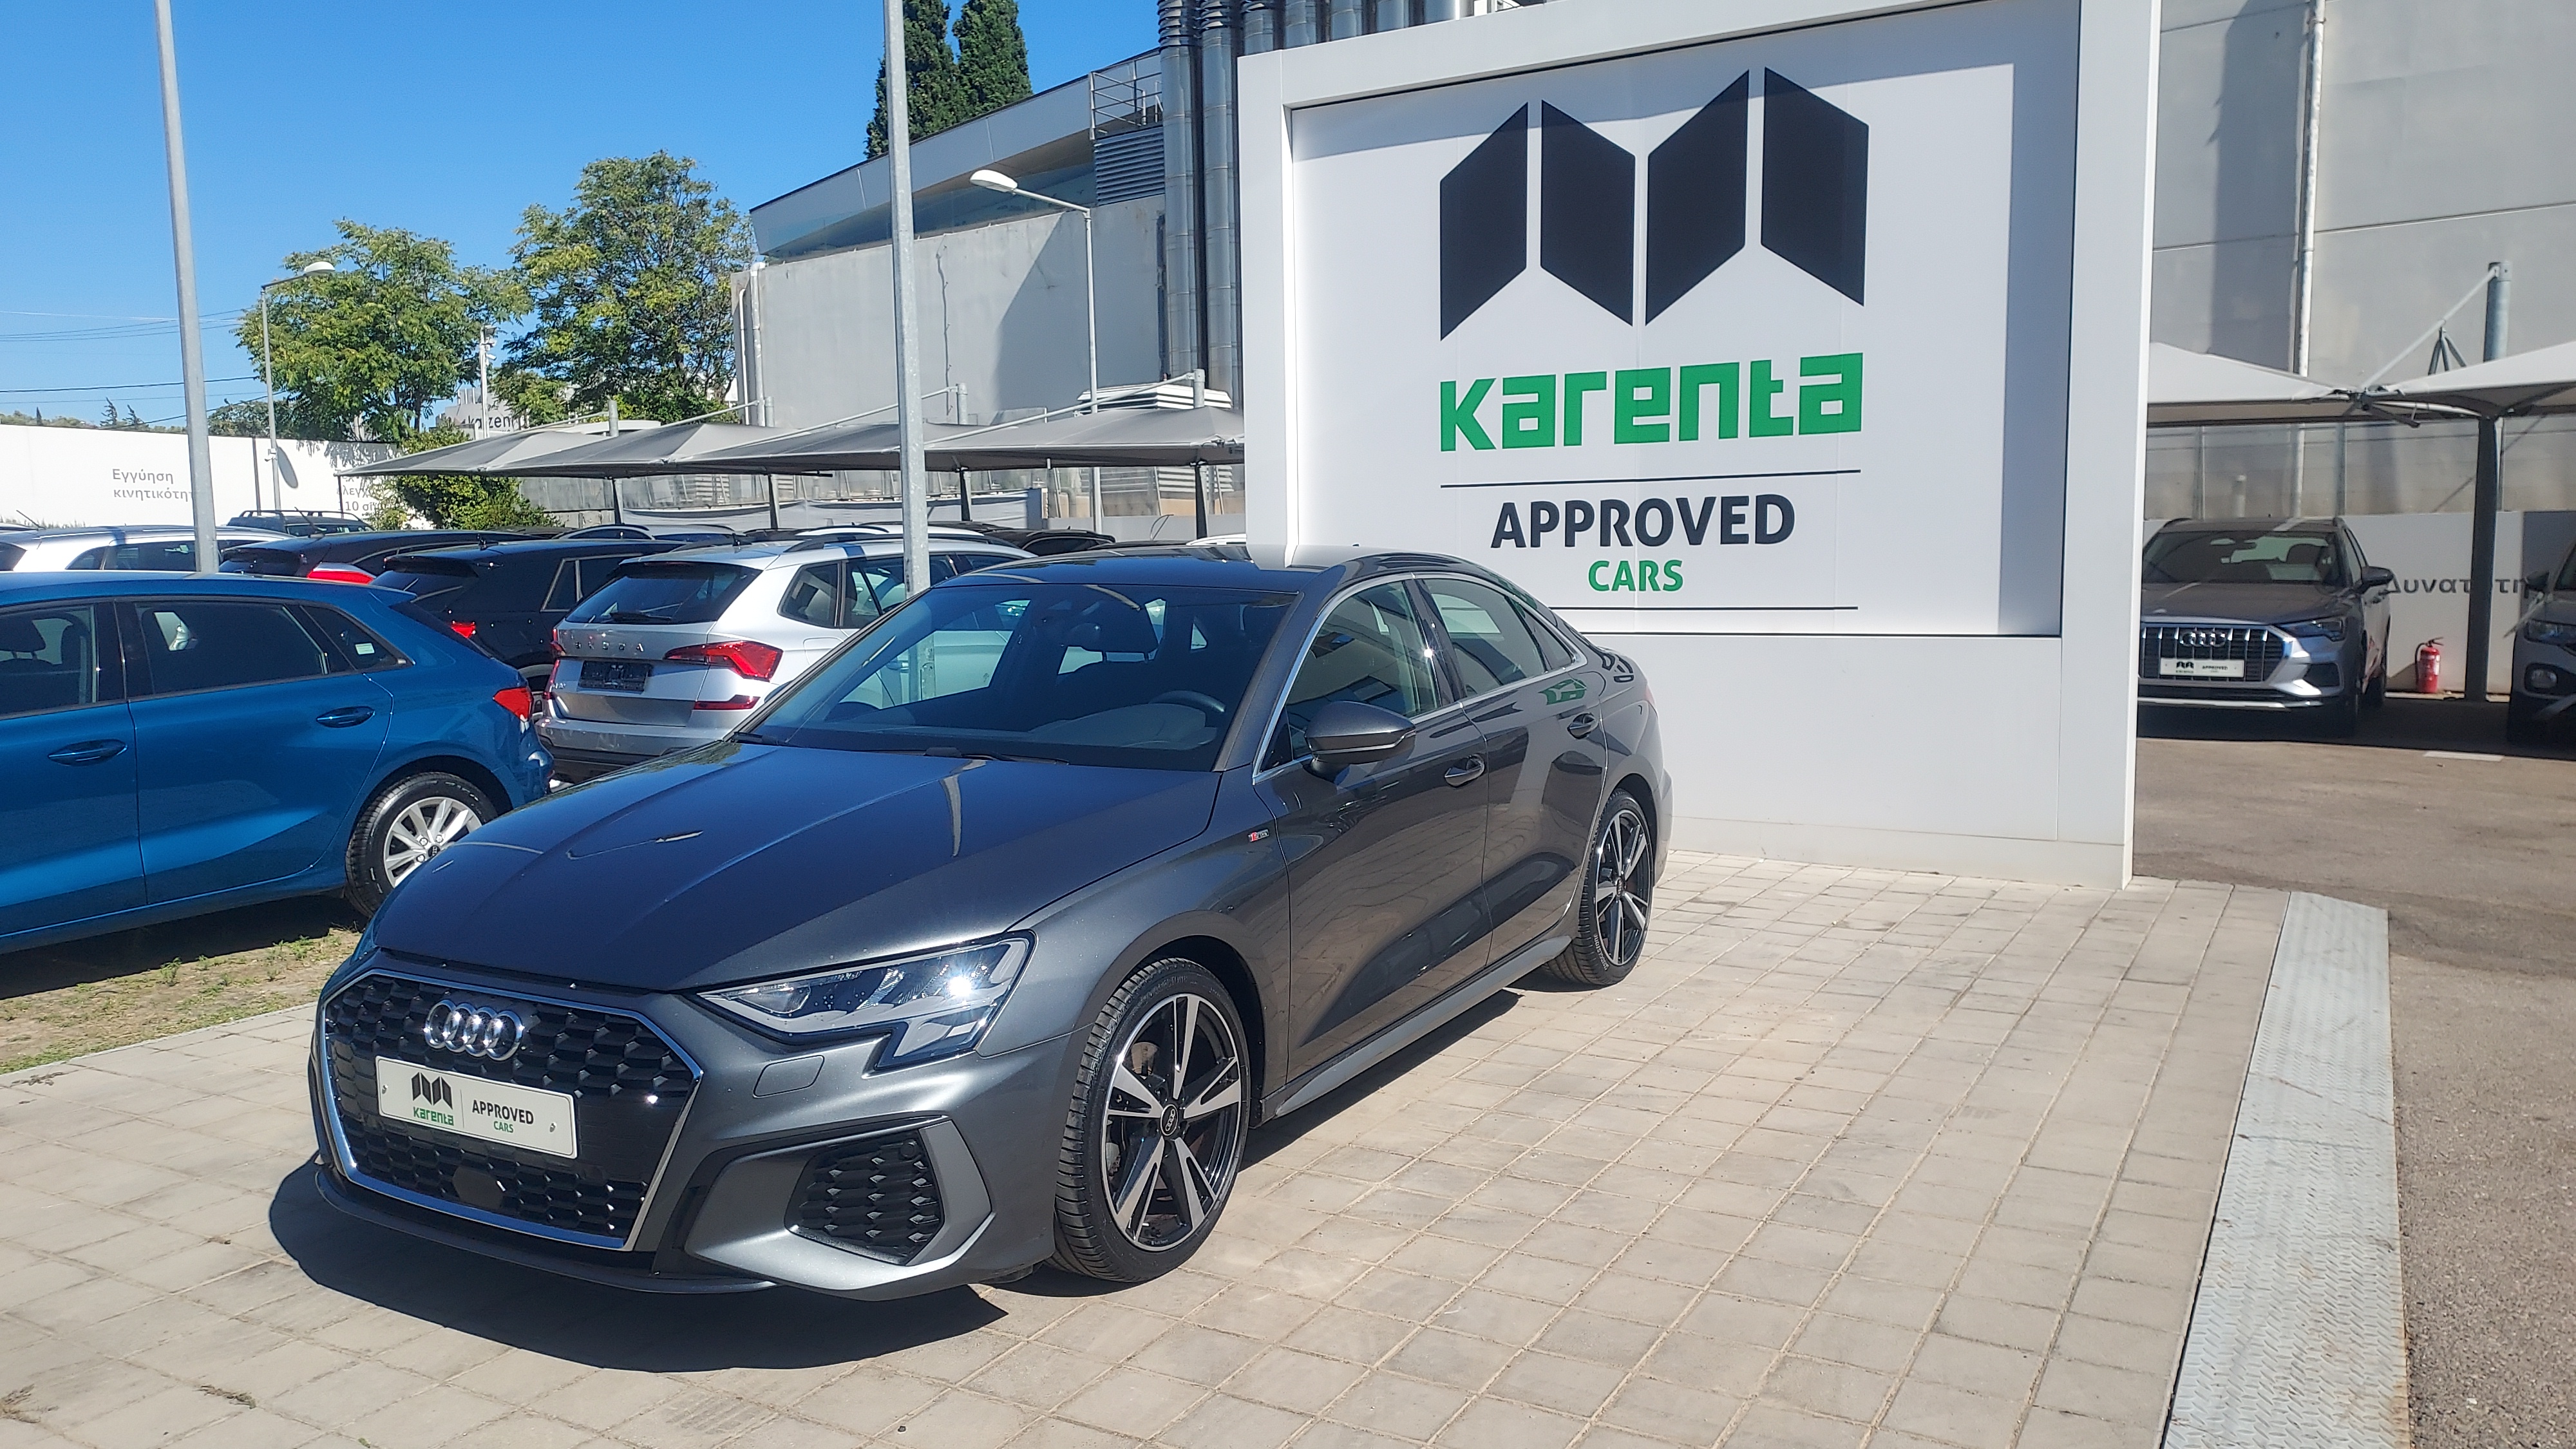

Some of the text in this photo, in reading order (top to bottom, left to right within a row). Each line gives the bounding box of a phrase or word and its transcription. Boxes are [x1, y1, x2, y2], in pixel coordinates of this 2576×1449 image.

[1440, 352, 1864, 452] karenta
[112, 468, 174, 484] Εγγύηση
[1490, 494, 1795, 549] APPROVED
[1588, 560, 1683, 592] CARS
[413, 1106, 454, 1126] karenta
[472, 1099, 534, 1124] APPROVED
[493, 1121, 514, 1133] CARS
